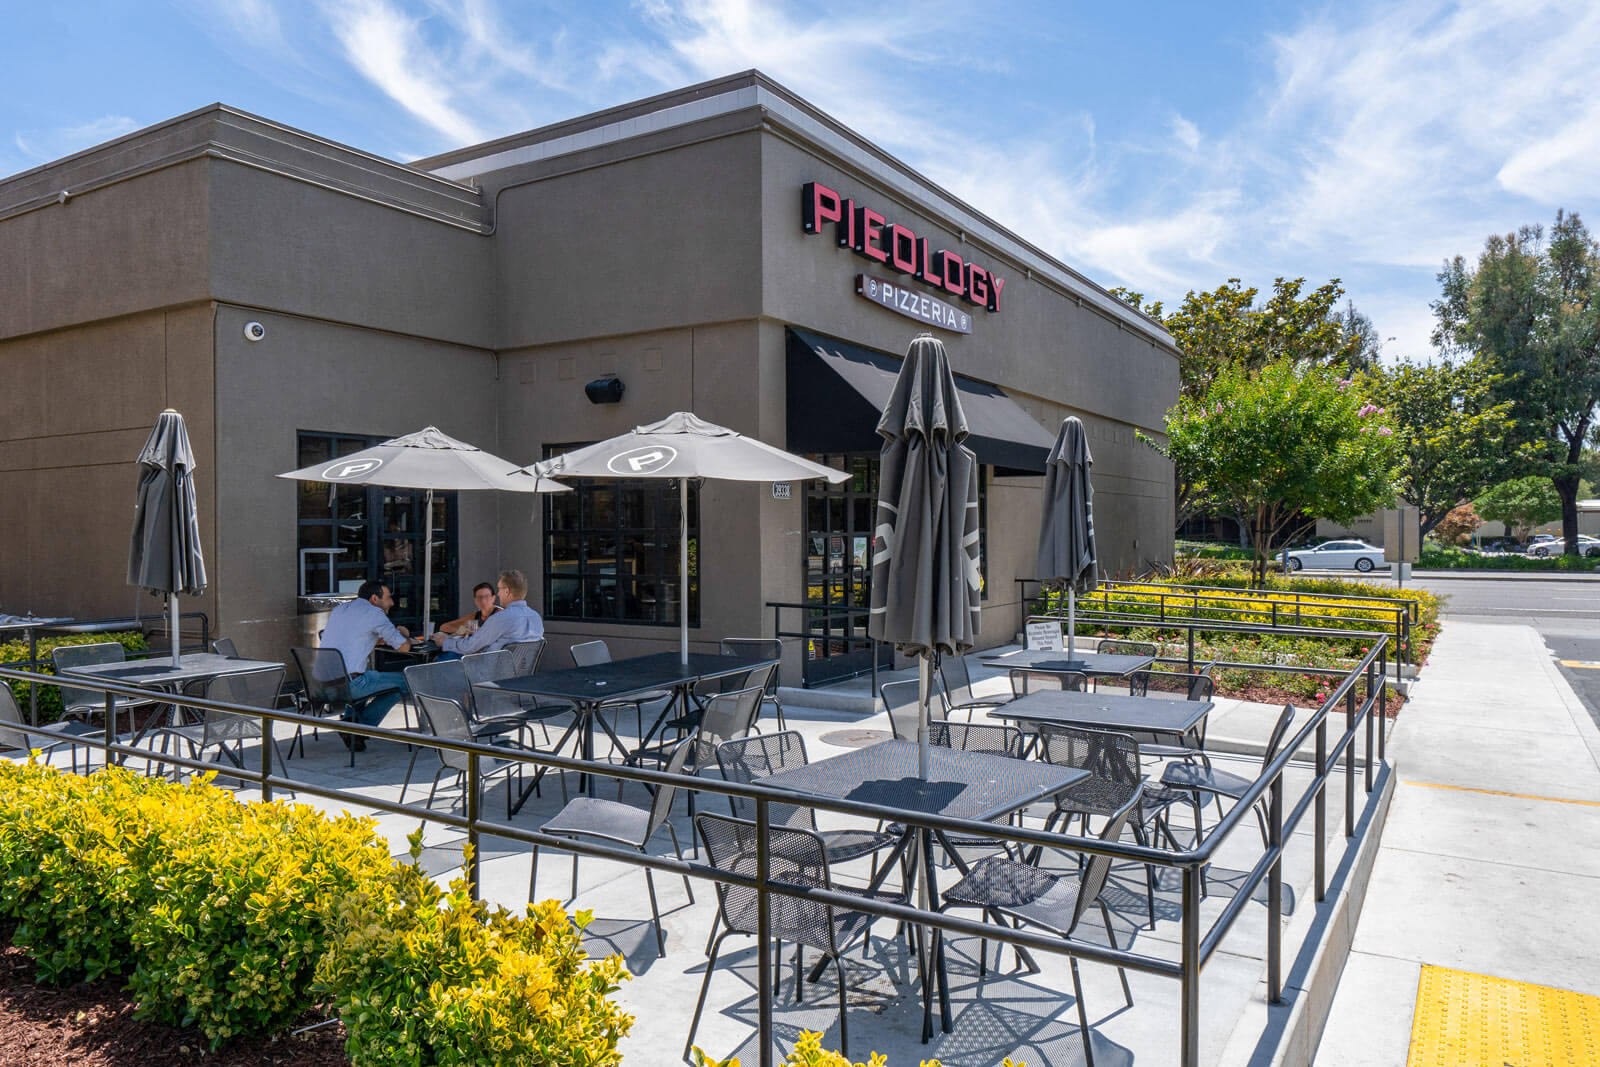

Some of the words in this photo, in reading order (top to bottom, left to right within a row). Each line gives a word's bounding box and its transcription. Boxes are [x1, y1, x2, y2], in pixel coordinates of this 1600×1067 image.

[804, 182, 1005, 312] PIEOLOGY
[882, 282, 958, 329] PIZZERIA
[340, 462, 372, 477] P
[629, 451, 665, 471] P
